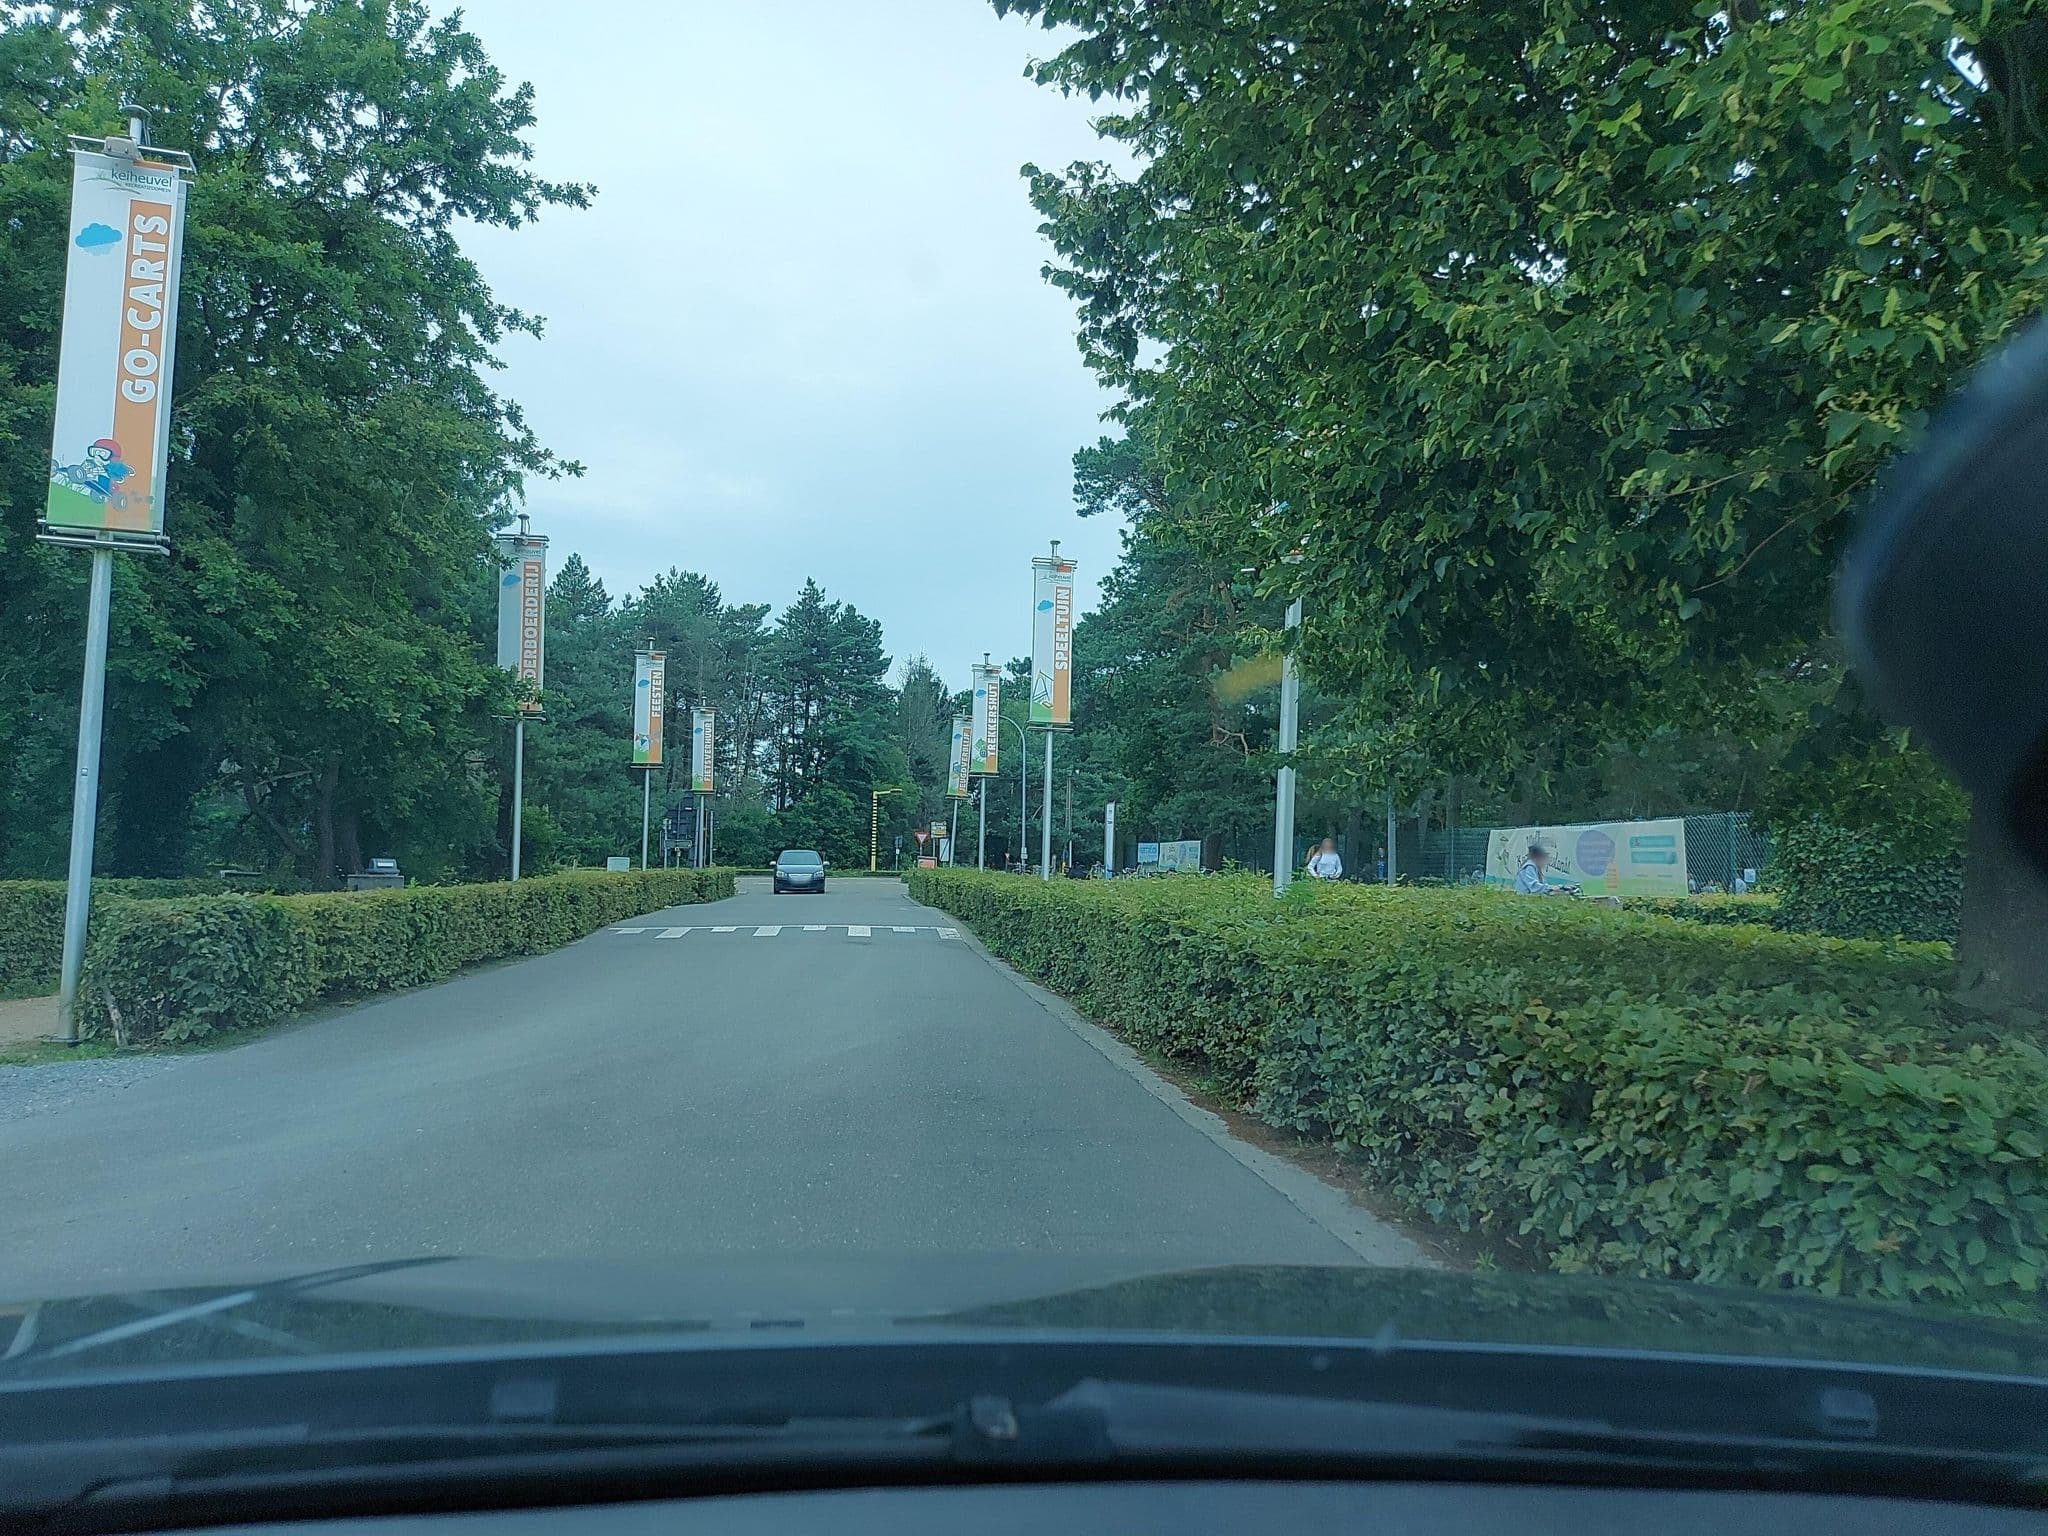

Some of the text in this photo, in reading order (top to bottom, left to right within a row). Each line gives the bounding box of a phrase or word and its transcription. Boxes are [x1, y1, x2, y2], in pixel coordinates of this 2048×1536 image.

[111, 168, 172, 188] keiheuvel
[121, 214, 168, 403] GO-CARTS
[523, 563, 541, 704] DERBOERDERIJ
[1055, 588, 1071, 671] SPEELTUIN
[652, 670, 662, 718] FEESTEN
[987, 683, 998, 756] TREKKERSHUT
[703, 721, 713, 782] FIETSVERHUUR
